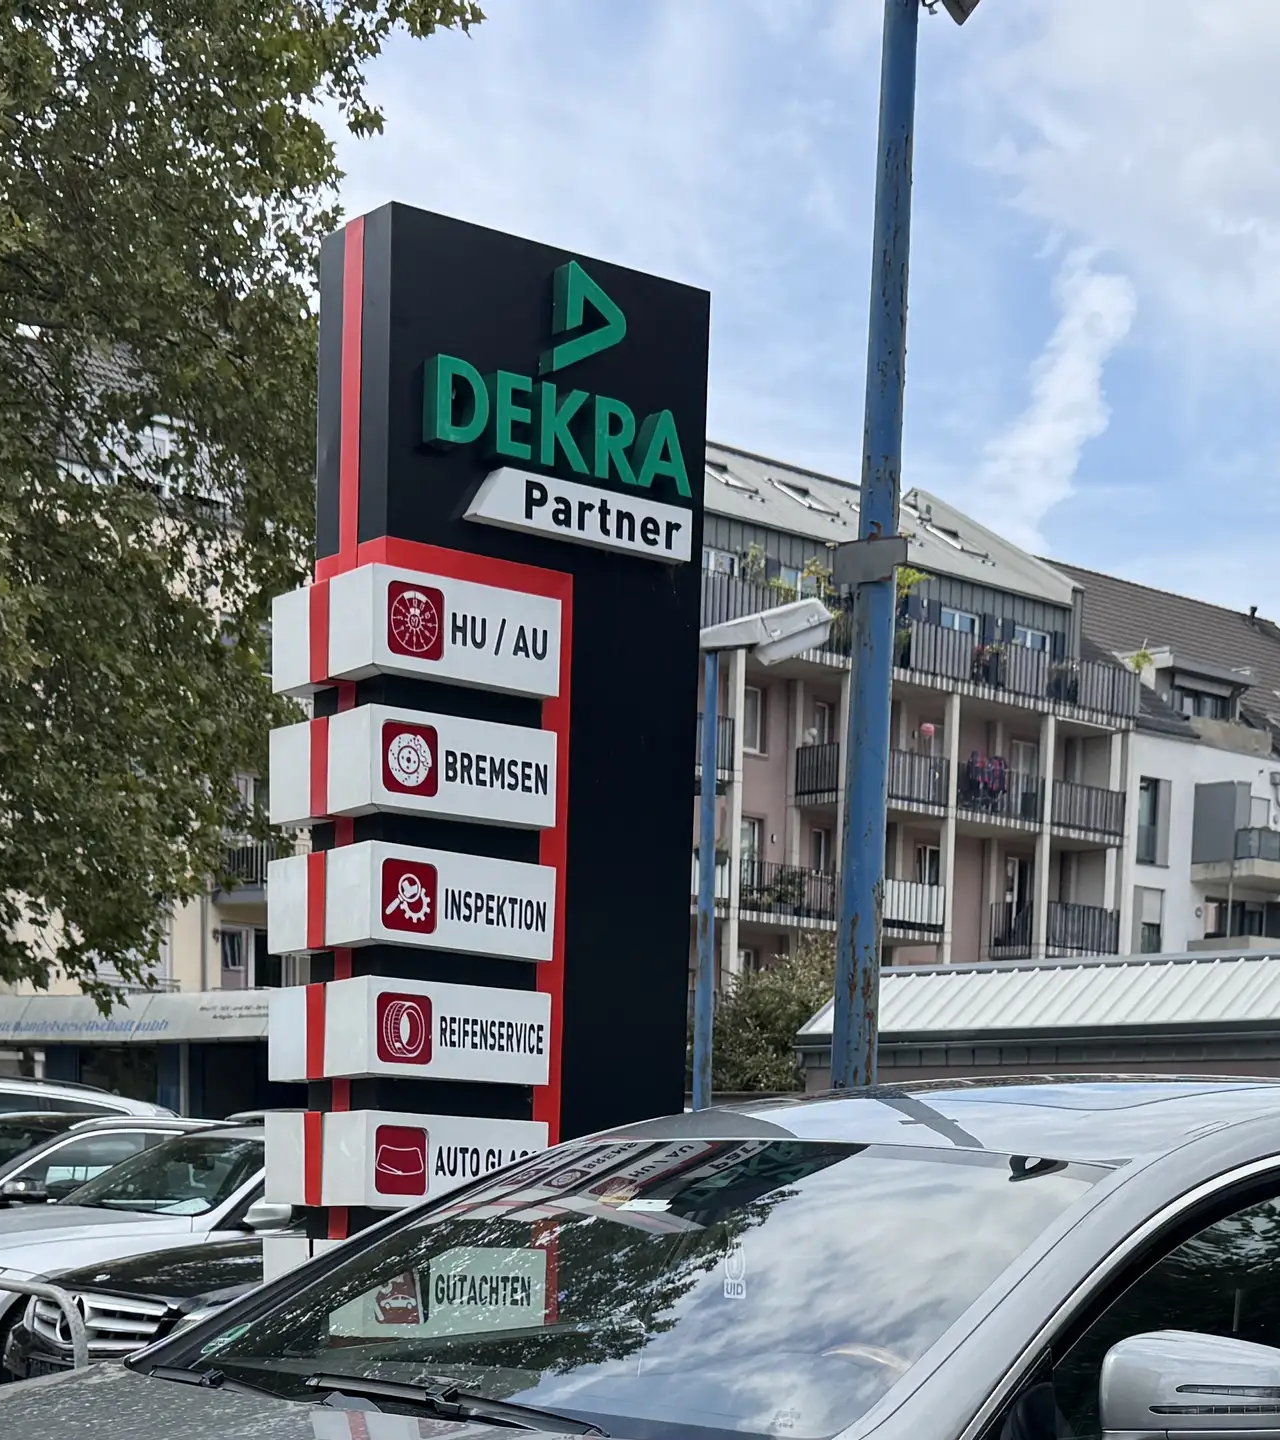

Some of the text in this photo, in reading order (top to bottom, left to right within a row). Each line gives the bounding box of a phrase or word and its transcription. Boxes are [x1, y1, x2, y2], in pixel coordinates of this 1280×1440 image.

[423, 353, 692, 498] DEKRA
[525, 479, 682, 550] Partner
[451, 612, 487, 650] HU
[512, 625, 548, 661] AU
[445, 750, 548, 796] BREMSEN
[444, 888, 547, 932] INSPEKTION
[440, 1016, 544, 1055] REIFENSERVICE
[435, 1146, 480, 1177] AUTO
[435, 1273, 531, 1306] GUTACHTEN
